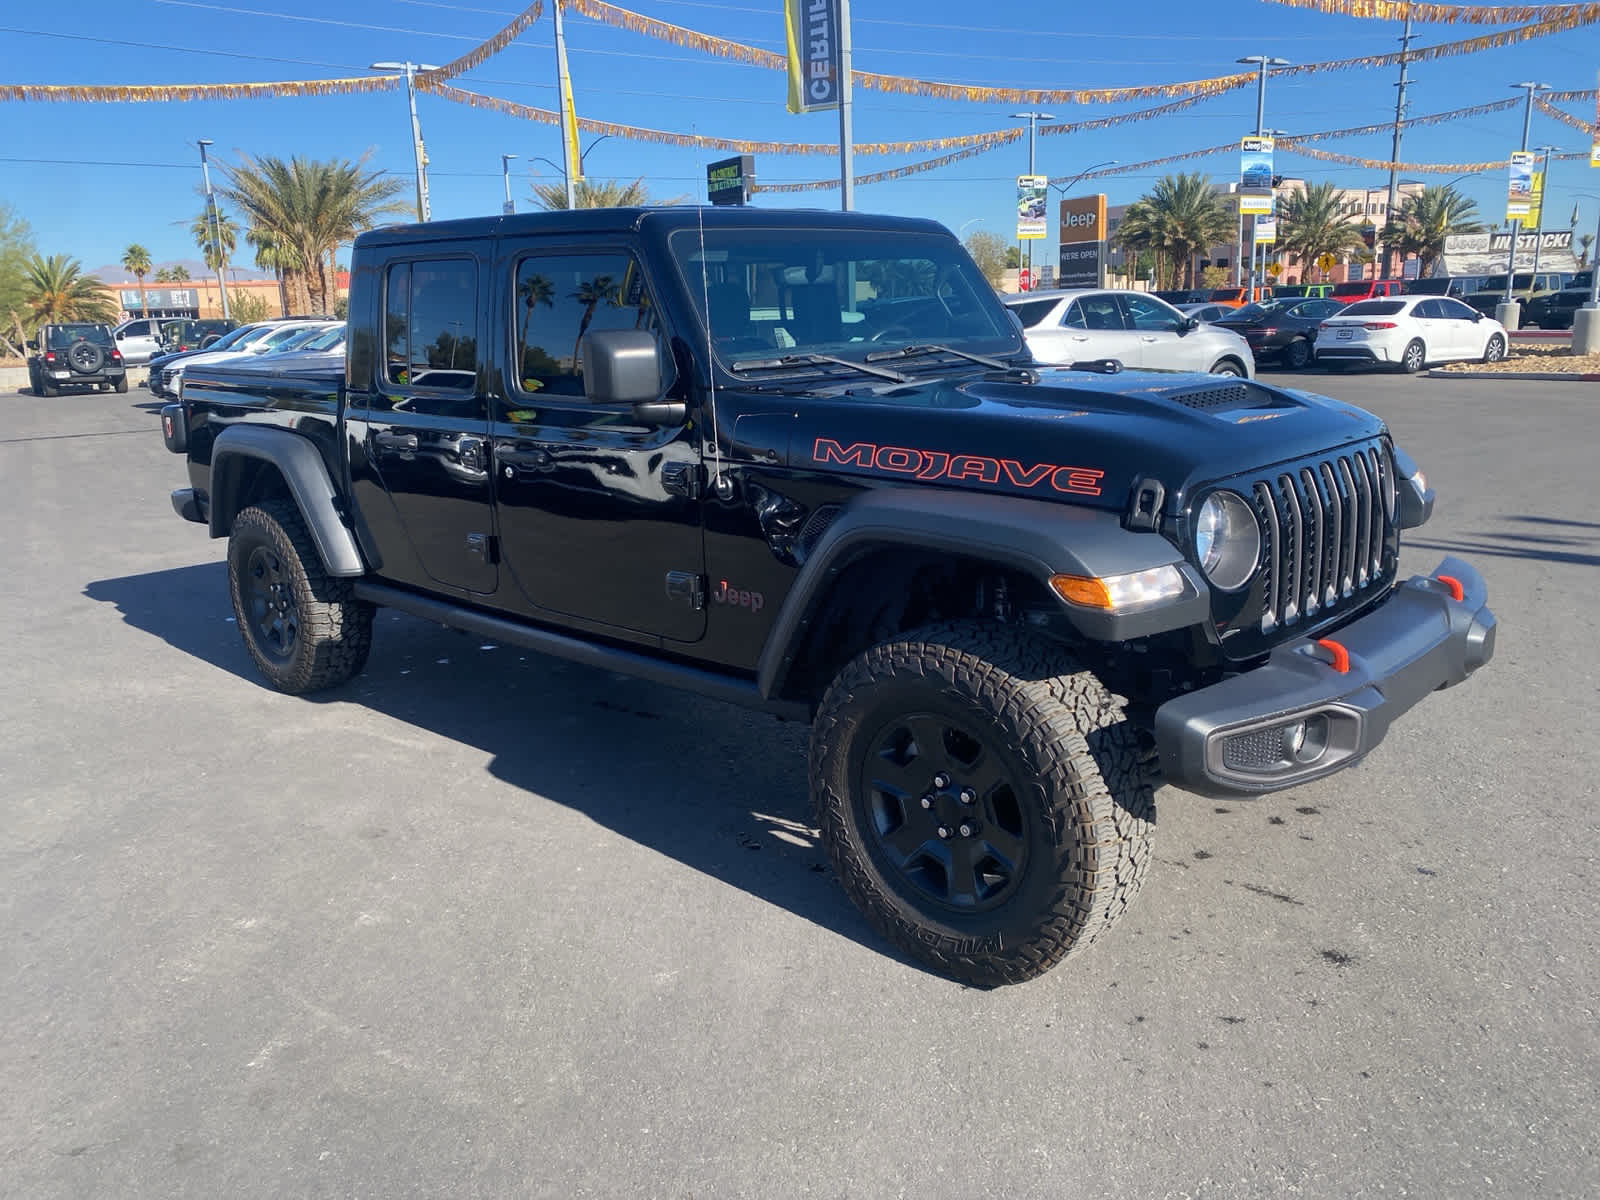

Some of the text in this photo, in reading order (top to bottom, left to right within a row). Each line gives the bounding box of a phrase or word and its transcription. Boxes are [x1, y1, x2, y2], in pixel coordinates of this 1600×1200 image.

[1062, 211, 1096, 228] Jeep
[1494, 235, 1511, 249] IN
[1515, 233, 1571, 249] STOCK!
[1080, 249, 1097, 259] OPEN
[813, 438, 1104, 496] MOJAVE
[713, 580, 764, 614] Jeep
